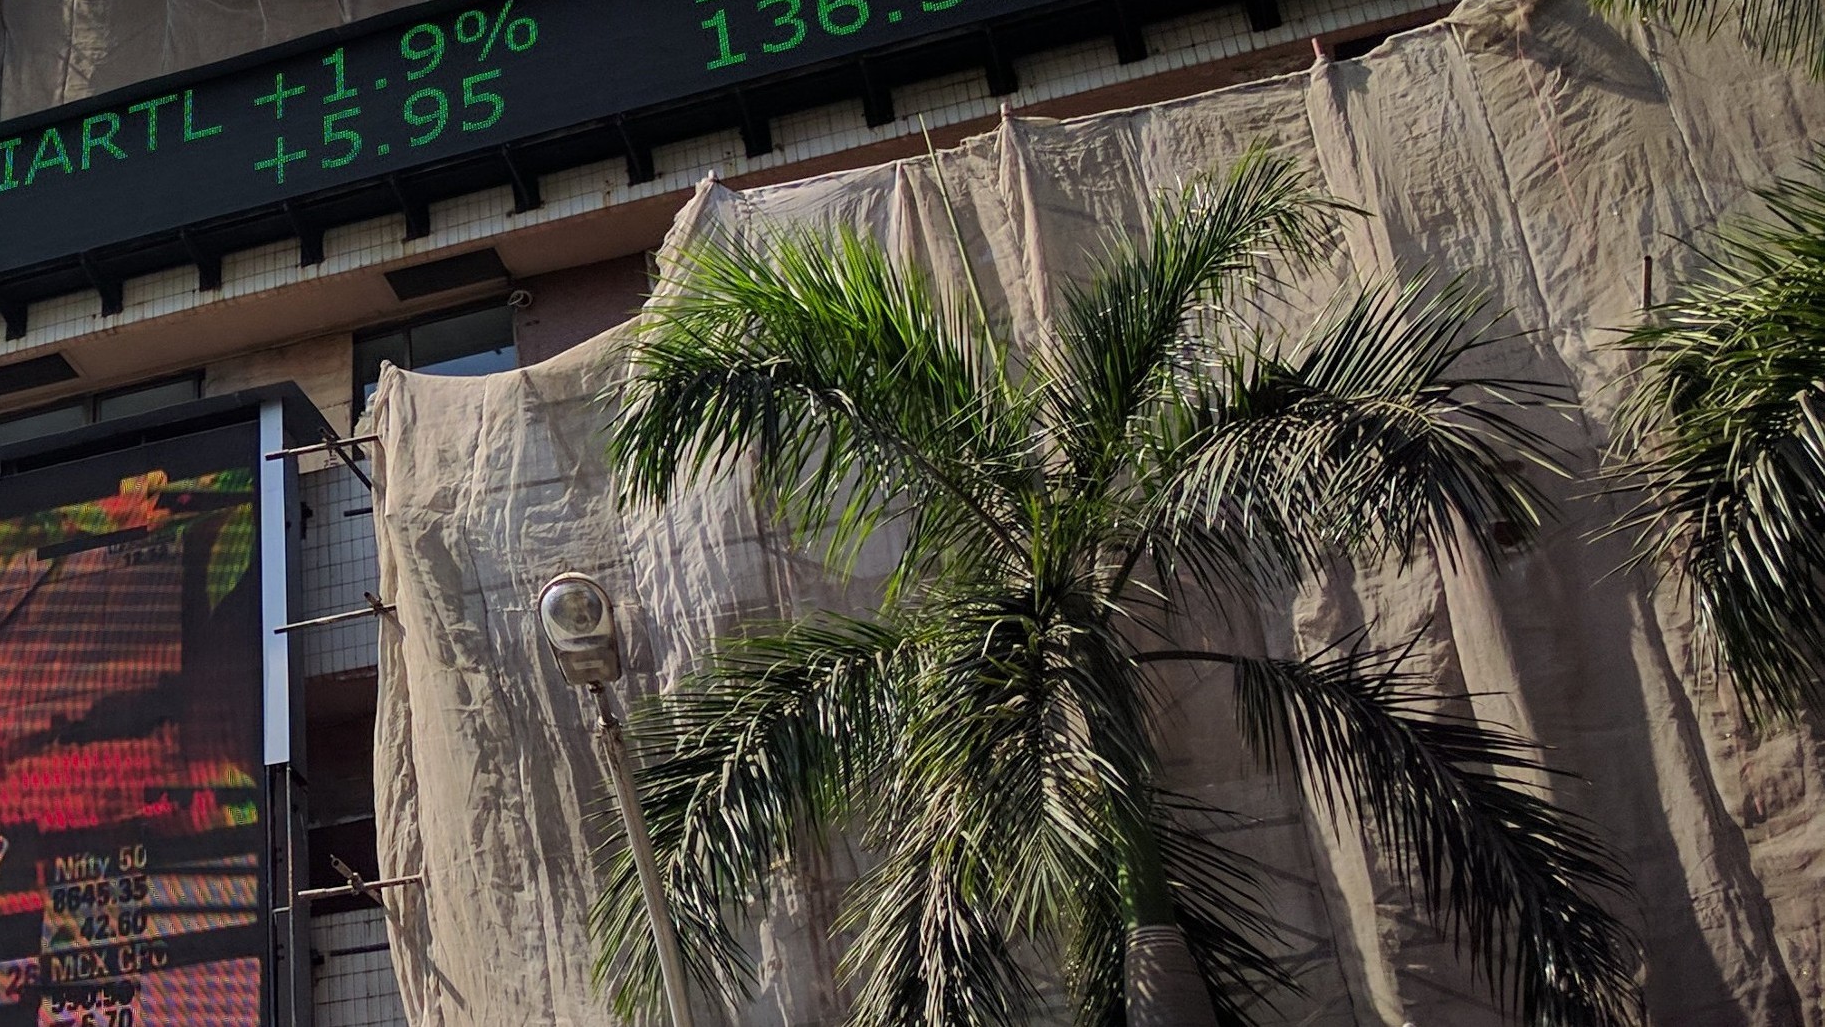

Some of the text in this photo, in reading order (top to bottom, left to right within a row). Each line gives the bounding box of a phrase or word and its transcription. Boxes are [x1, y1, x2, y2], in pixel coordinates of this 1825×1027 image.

[254, 0, 539, 120] +1.9%
[254, 68, 506, 184] +5.95
[55, 843, 148, 883] Nifty 50
[50, 950, 110, 983] MCX
